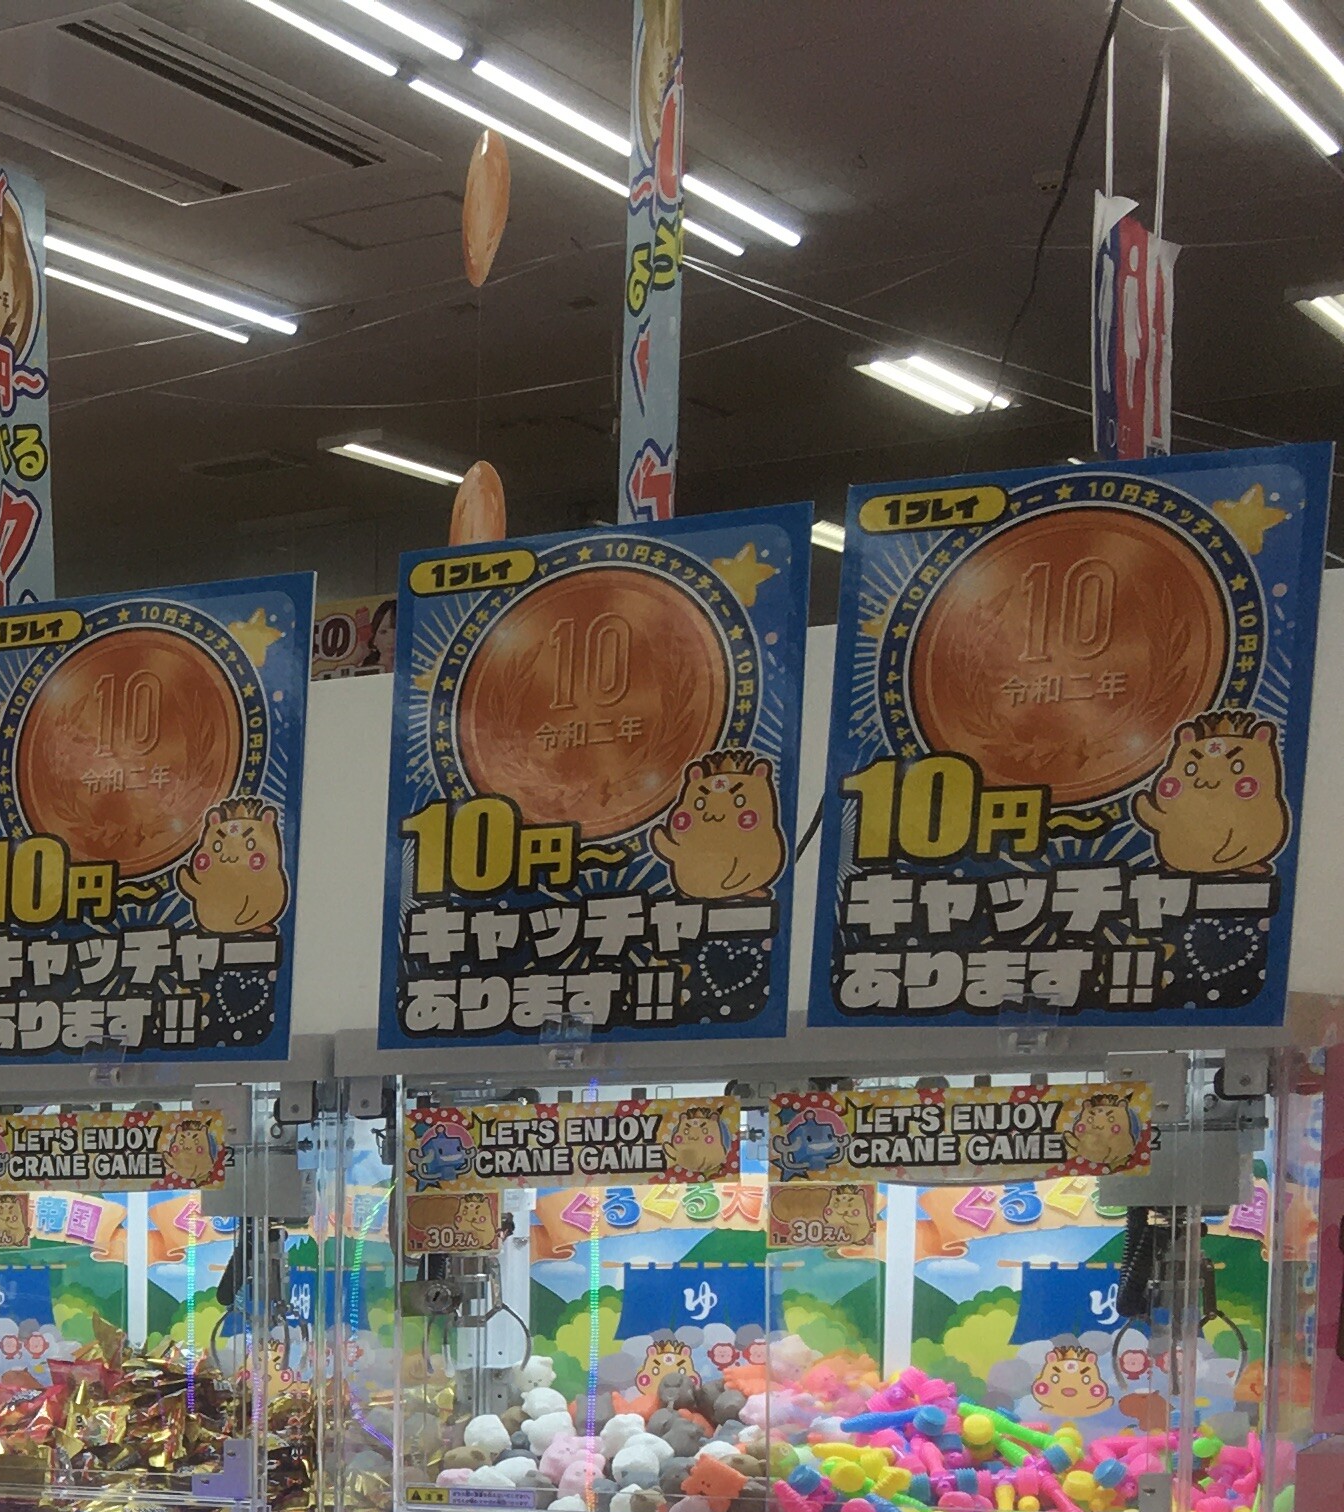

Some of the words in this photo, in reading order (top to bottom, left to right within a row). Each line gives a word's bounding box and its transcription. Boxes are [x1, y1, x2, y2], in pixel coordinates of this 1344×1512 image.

[883, 499, 980, 526] 1プレイ
[431, 559, 512, 588] 1プレイ
[1019, 557, 1117, 663] 10
[549, 612, 632, 710] 10
[1001, 671, 1126, 706] 令和二年
[95, 670, 163, 758] 10
[535, 717, 643, 752] 令和二年
[81, 765, 170, 792] 令和二年
[844, 866, 1273, 935] キャッチャー
[406, 896, 777, 960] キャッチャー
[481, 1118, 556, 1147] LET'S
[566, 1113, 659, 1143] ENJOY
[856, 1104, 941, 1135] LET'S
[953, 1100, 1059, 1131] ENJOY
[13, 1127, 75, 1153] LET'S
[83, 1125, 159, 1150] ENJOY
[847, 1133, 957, 1167] CRANE
[966, 1131, 1065, 1163] GAME
[7, 1152, 87, 1179] CRANE
[93, 1151, 164, 1177] GAME
[474, 1144, 571, 1177] CRANE
[578, 1142, 665, 1172] GAME
[682, 1286, 718, 1322] ゆ
